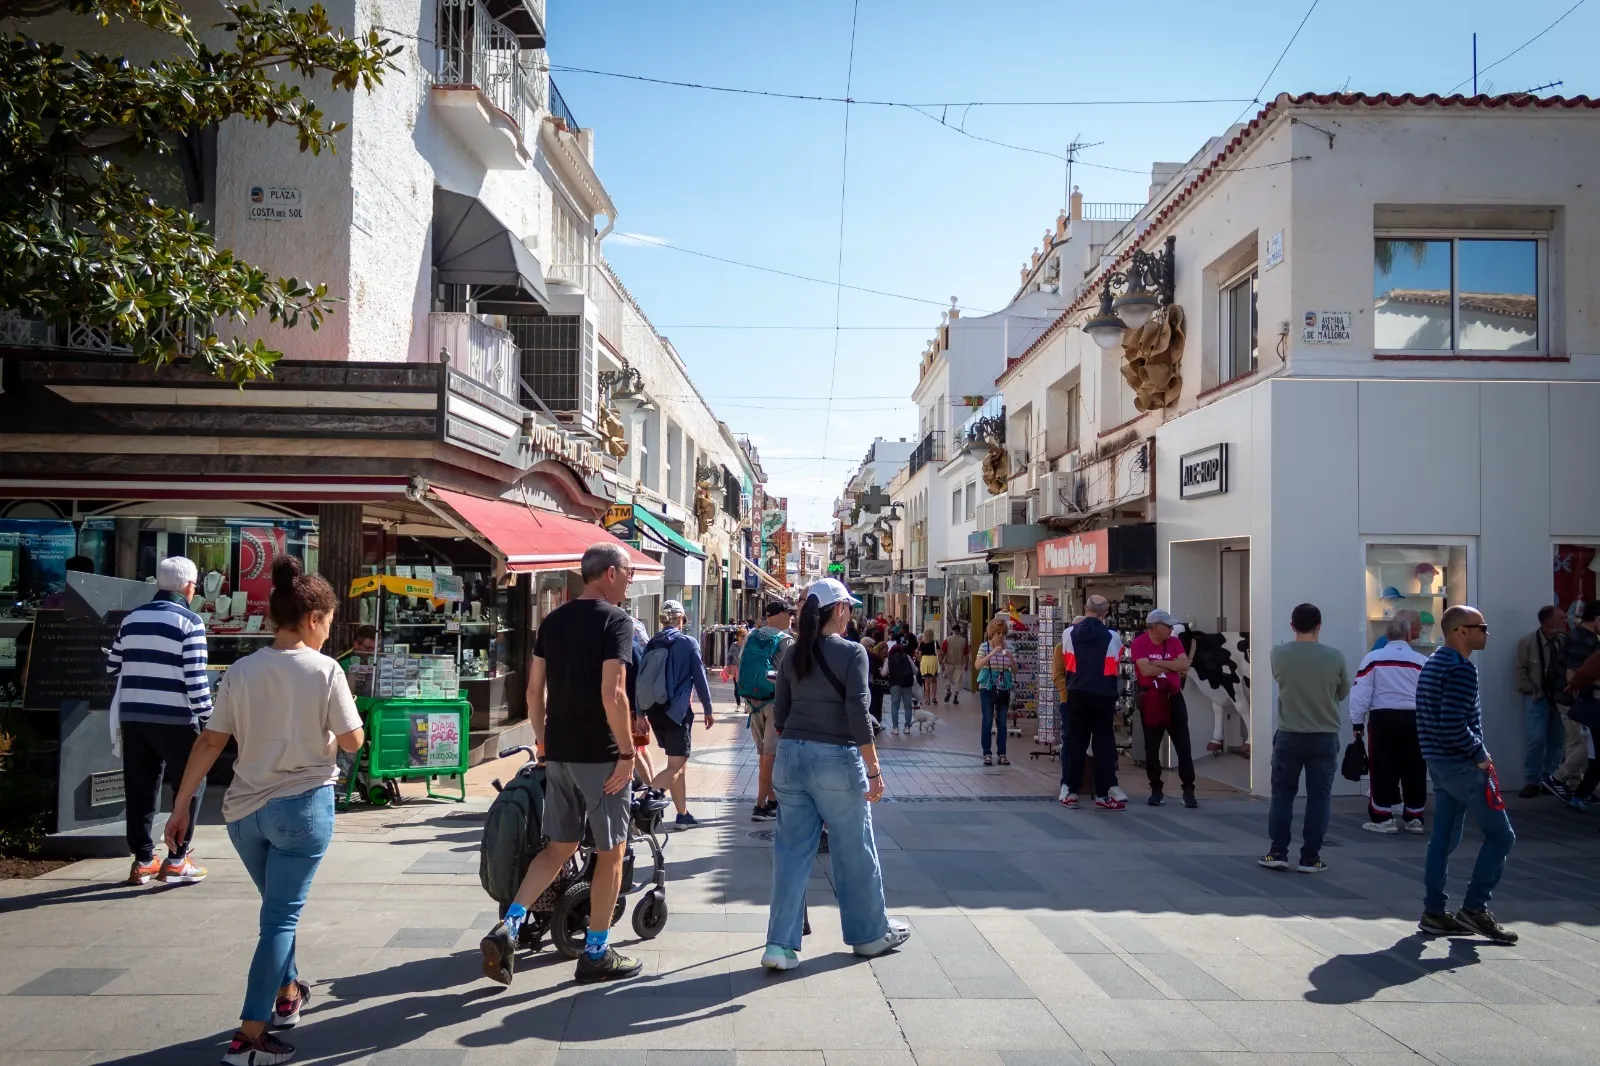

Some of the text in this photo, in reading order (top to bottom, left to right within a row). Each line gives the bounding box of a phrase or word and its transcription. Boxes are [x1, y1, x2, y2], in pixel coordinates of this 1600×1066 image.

[270, 190, 296, 200] PLAZA
[251, 207, 303, 218] COSTA DEL SOL
[1321, 316, 1344, 325] AVENIDA
[1321, 324, 1346, 332] PALMA
[1306, 331, 1350, 340] DE MALLORCA
[1183, 458, 1219, 487] ALE-HOP
[606, 507, 631, 517] ATM
[753, 487, 761, 555] CHANGE
[188, 535, 229, 544] MAJORICA
[246, 599, 269, 608] MAJORI
[431, 720, 446, 732] DÍA
[446, 721, 457, 729] DEL
[430, 728, 459, 749] PADRE
